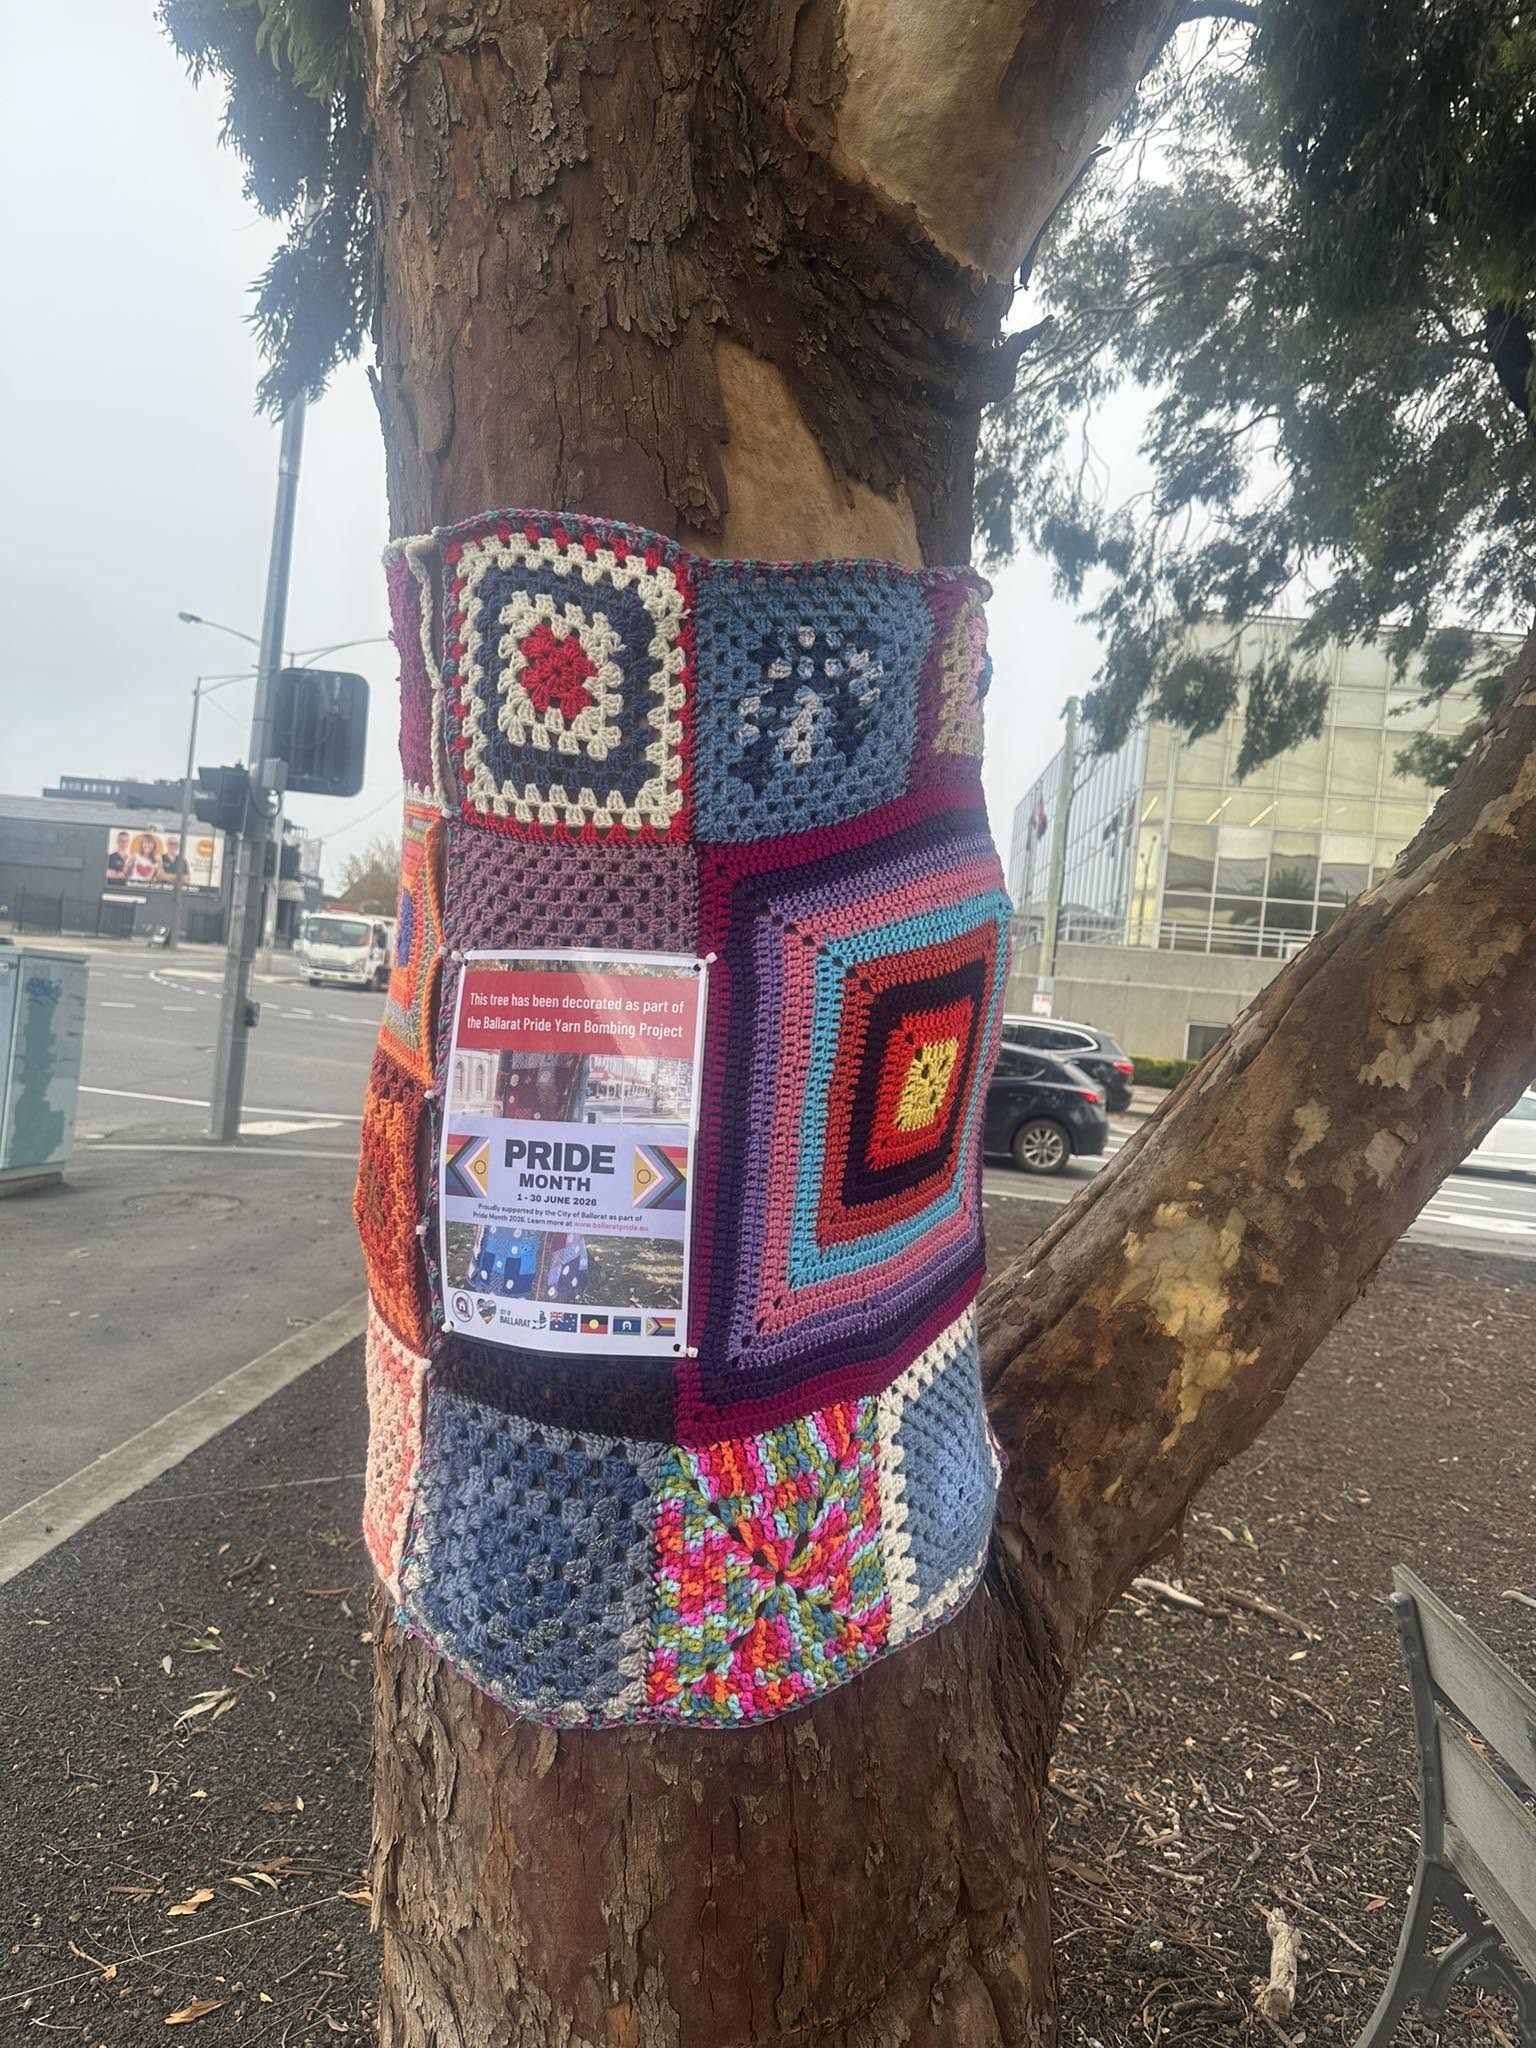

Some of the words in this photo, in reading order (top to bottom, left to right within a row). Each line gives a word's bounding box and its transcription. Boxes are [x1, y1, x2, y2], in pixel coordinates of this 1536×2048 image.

[470, 993, 488, 1006] This
[490, 994, 509, 1006] tree
[511, 993, 530, 1007] has
[532, 994, 559, 1008] been
[562, 995, 622, 1010] decorated
[625, 1000, 640, 1011] as
[643, 1001, 669, 1015] part
[671, 1001, 685, 1014] of
[467, 1016, 481, 1029] the
[483, 1016, 521, 1031] Ballarat
[523, 1017, 552, 1032] Pride
[555, 1018, 581, 1033] Yarn
[584, 1020, 636, 1039] Bombing
[639, 1022, 683, 1040] Project
[504, 1138, 616, 1175] PRIDE
[519, 1173, 591, 1192] MONTH
[530, 1194, 542, 1203] 30
[544, 1195, 571, 1205] JUNE
[573, 1197, 597, 1207] 2026
[473, 1211, 488, 1219] Pride
[488, 1213, 508, 1222] Month
[478, 1203, 500, 1212] Proudly
[501, 1206, 534, 1215] supported
[535, 1208, 543, 1216] by
[544, 1209, 556, 1217] the
[557, 1210, 571, 1218] City
[581, 1211, 607, 1220] Ballarat
[618, 1215, 633, 1223] part
